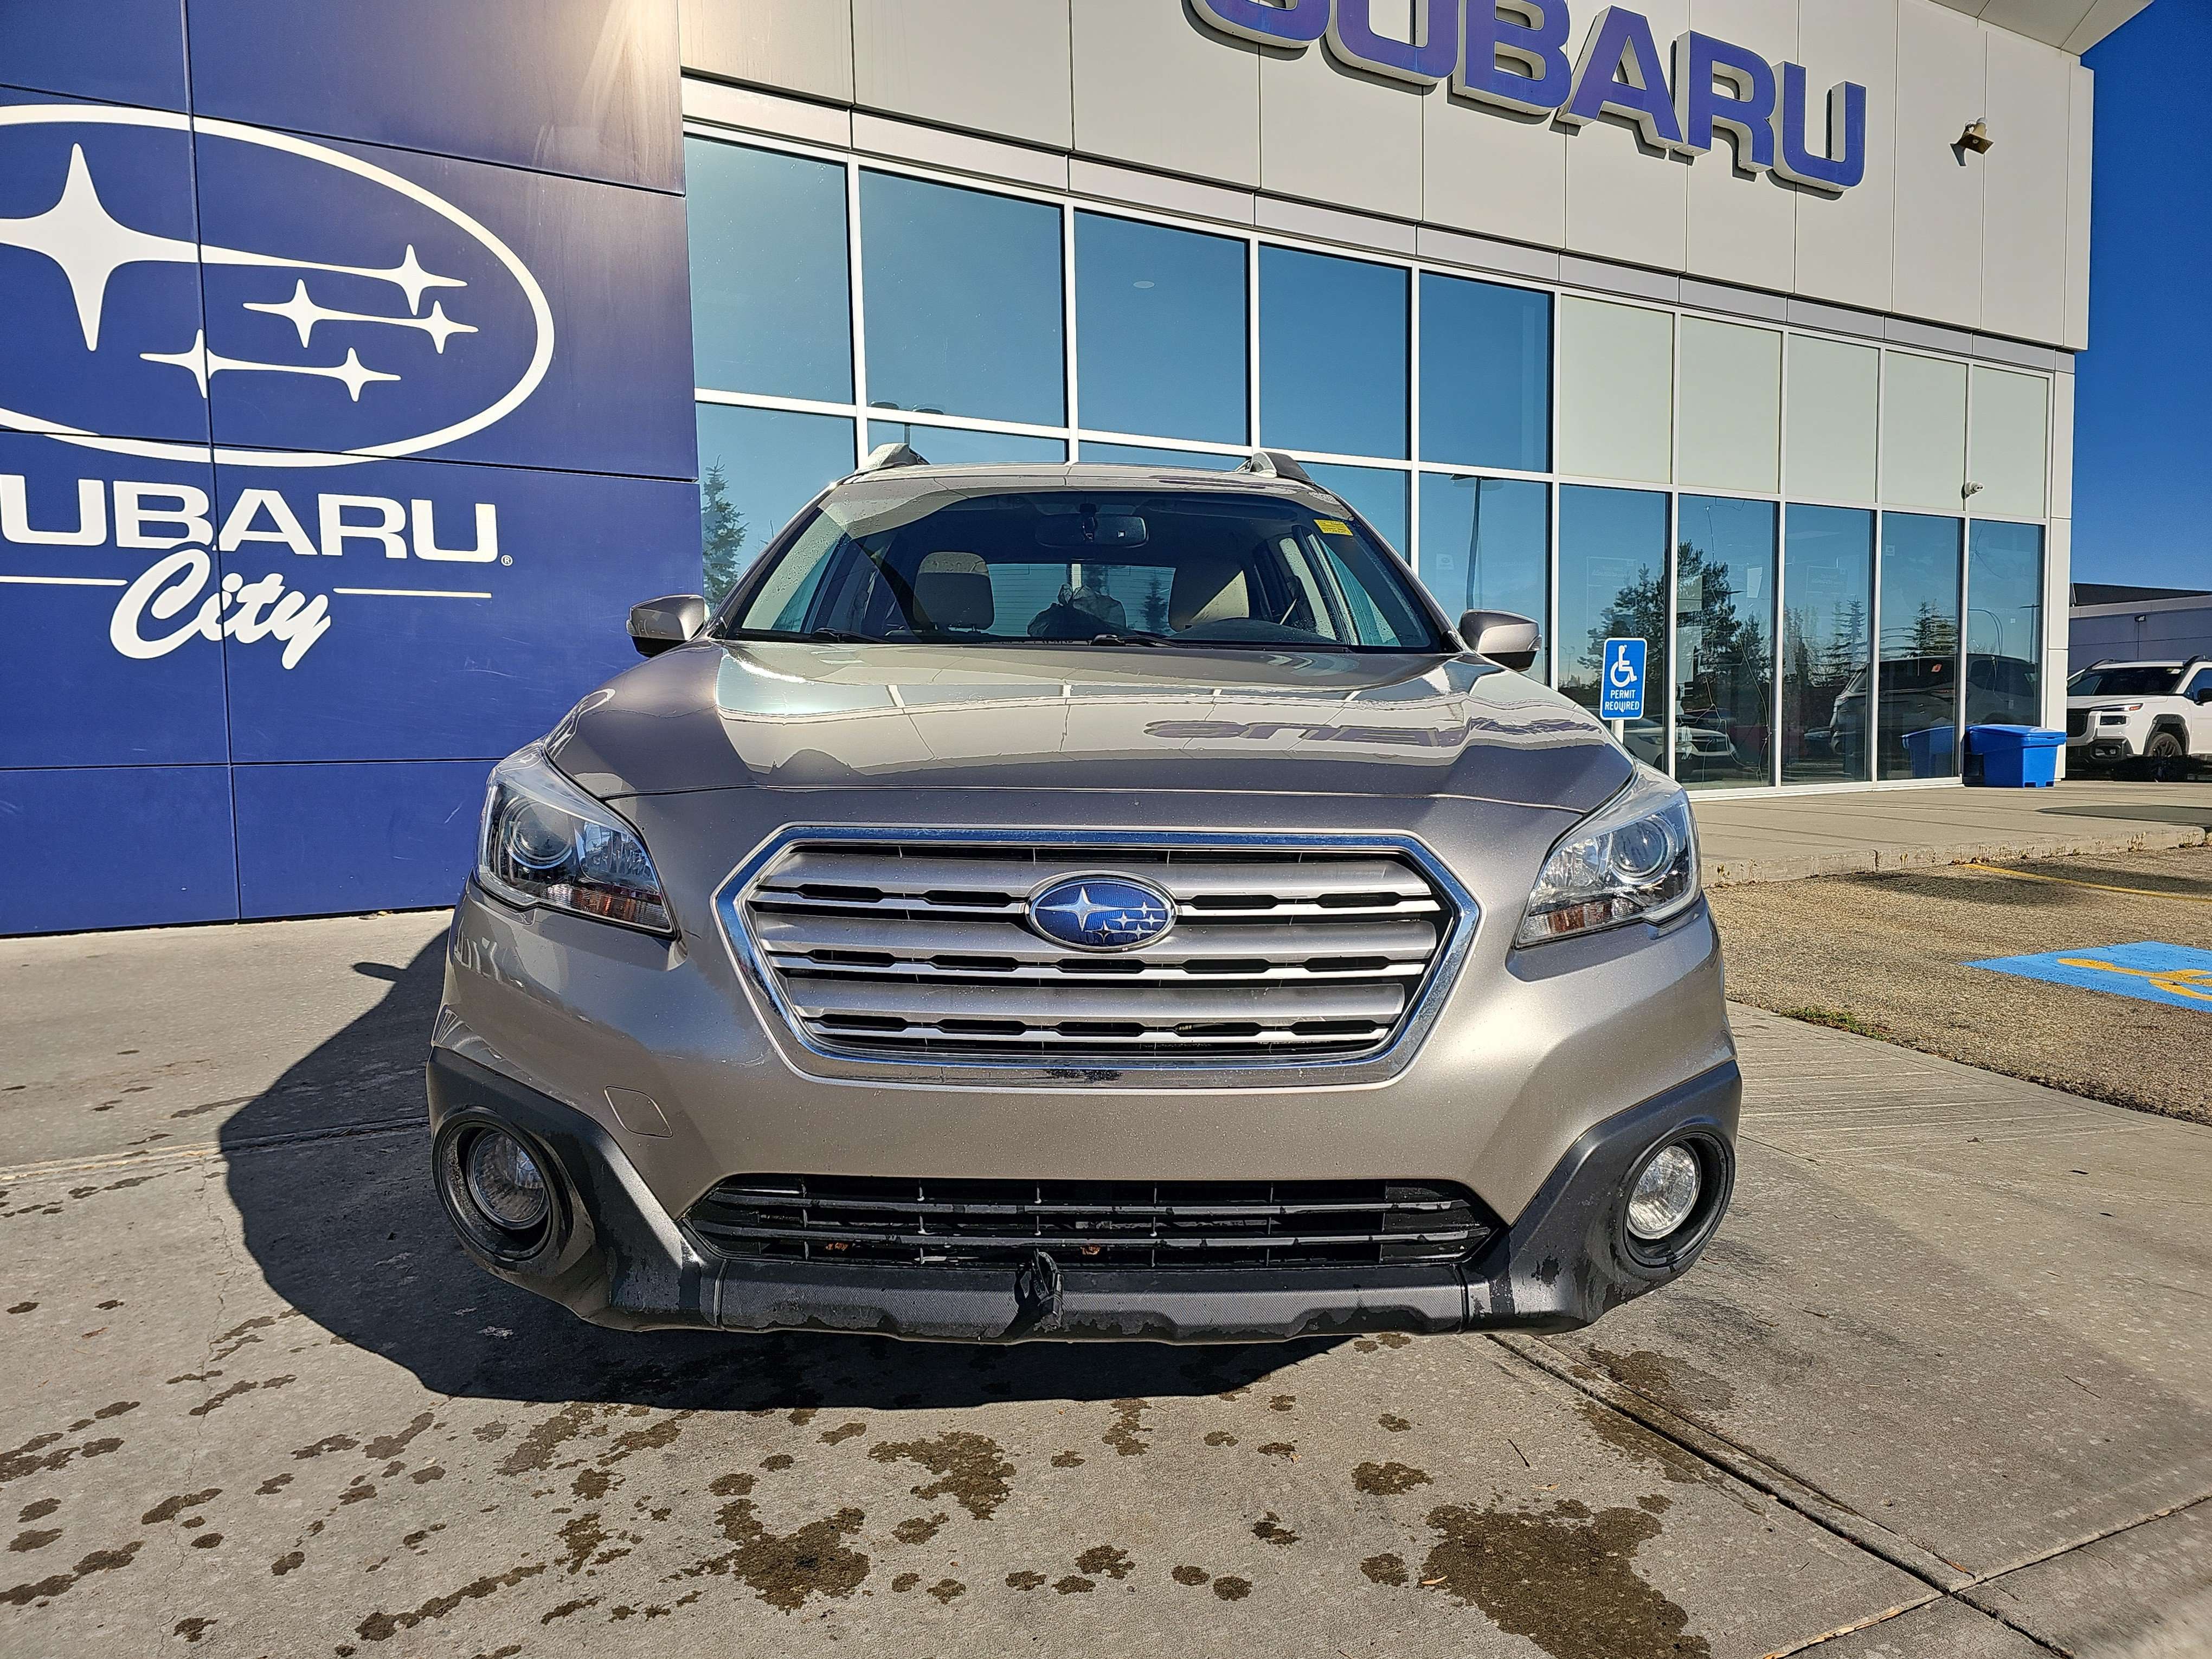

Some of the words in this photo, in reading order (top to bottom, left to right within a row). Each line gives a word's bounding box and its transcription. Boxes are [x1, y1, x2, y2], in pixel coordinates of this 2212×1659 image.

[110, 548, 331, 670] City
[1610, 689, 1636, 699] PERMIT
[1604, 701, 1640, 711] REQUIRED
